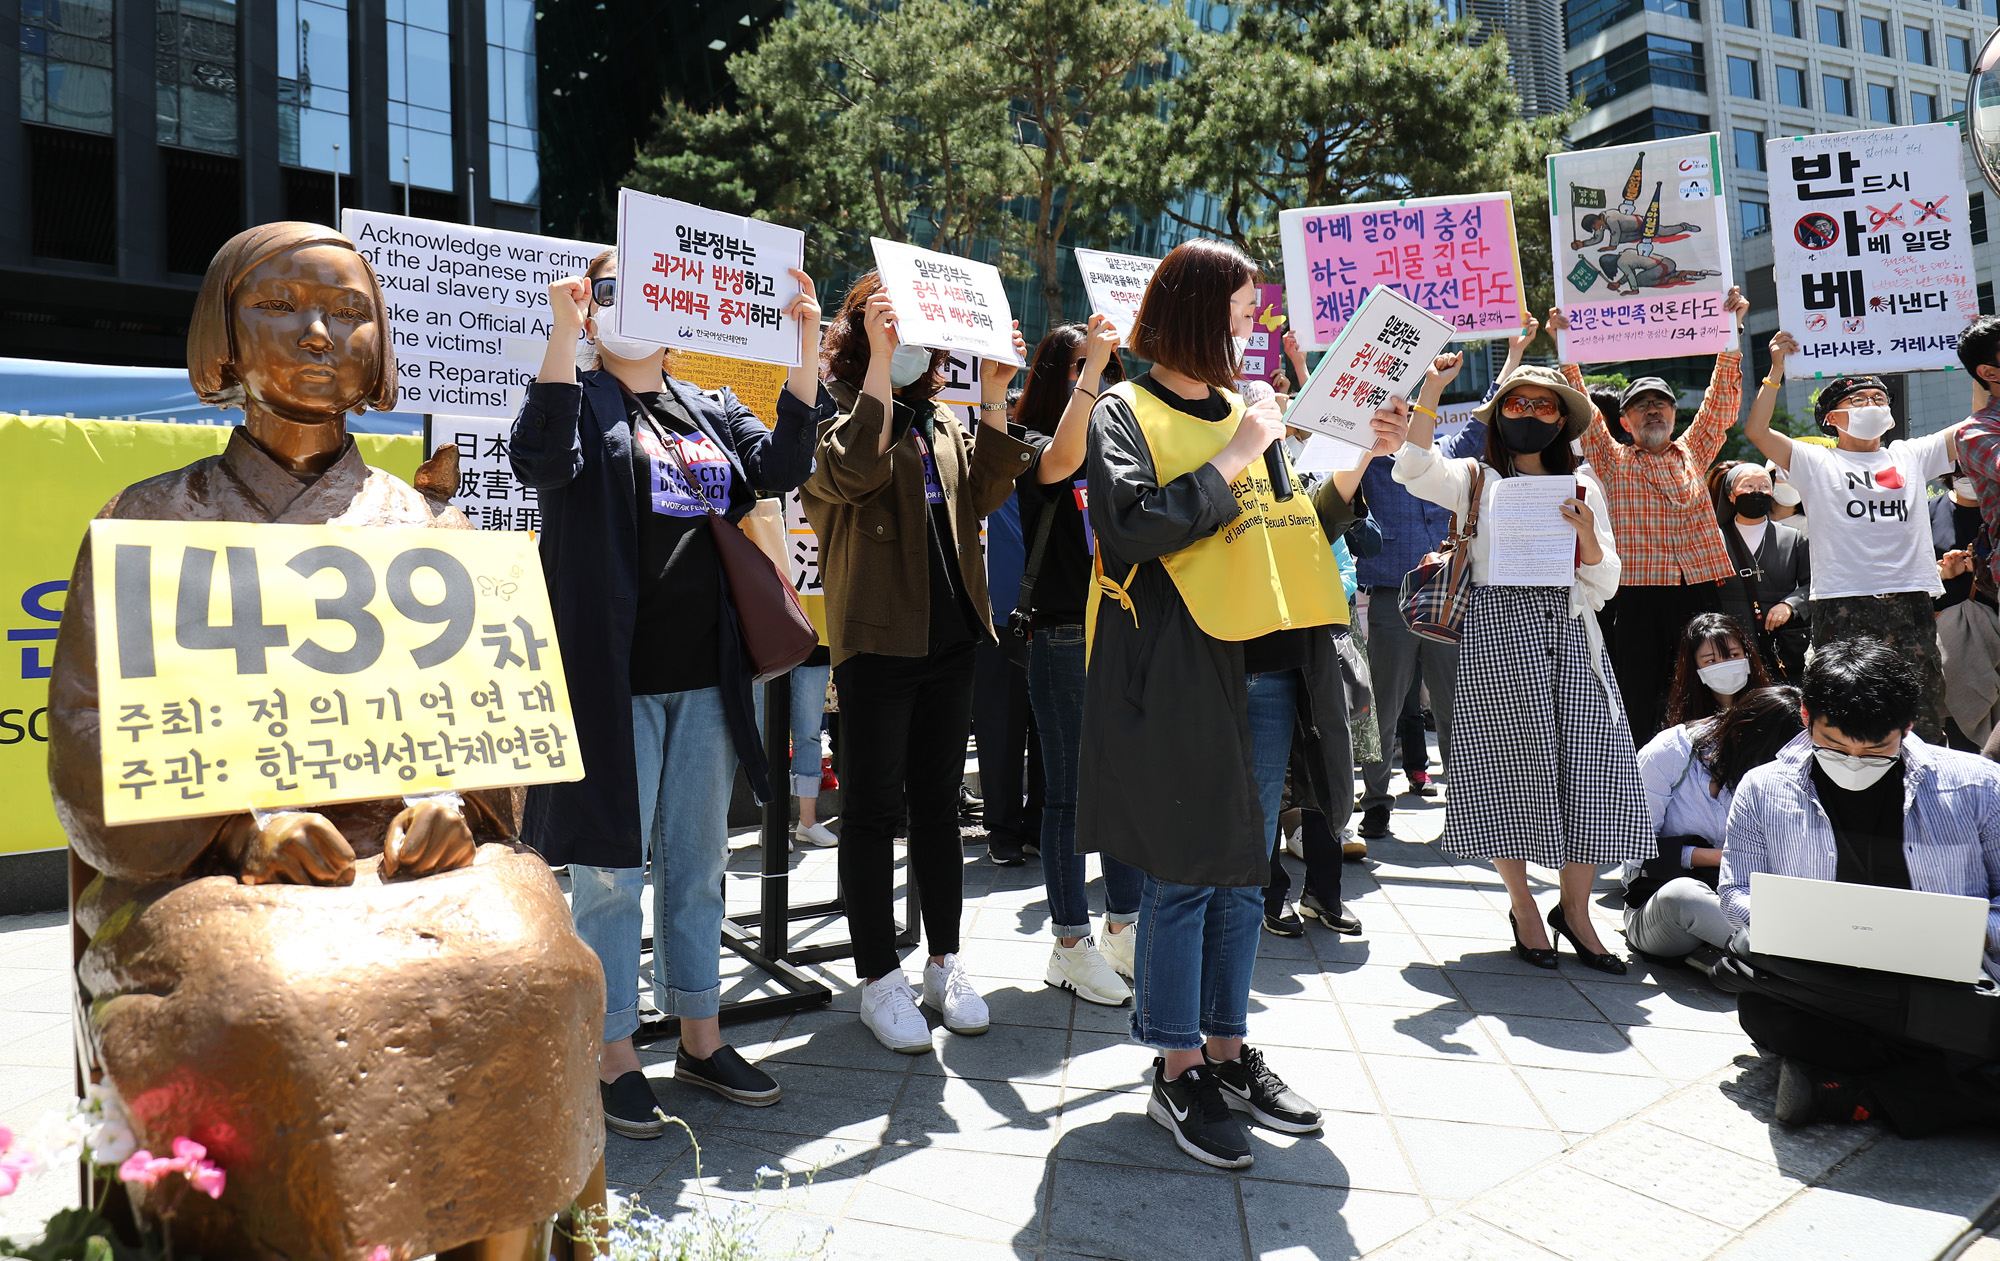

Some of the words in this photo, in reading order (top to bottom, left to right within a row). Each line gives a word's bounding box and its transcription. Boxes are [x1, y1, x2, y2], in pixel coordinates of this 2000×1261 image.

[1791, 151, 1911, 201] 반드시
[1306, 215, 1352, 243] 아베
[1361, 210, 1425, 243] 일당에
[1434, 206, 1482, 242] 충성
[360, 223, 501, 260] Acknowledge
[507, 245, 544, 263] war
[675, 225, 757, 266] 일본정부는
[1902, 229, 1952, 253] 일당
[361, 248, 382, 263] of
[387, 251, 420, 269] the
[427, 254, 527, 282] Japanese
[652, 252, 705, 285] 과거사
[712, 264, 776, 297] 반성하고
[914, 259, 972, 286] 일본정부는
[1311, 257, 1357, 287] 하는
[1373, 243, 1425, 280] 괴물
[1433, 237, 1491, 278] 집단
[378, 272, 429, 293] exual
[436, 278, 509, 305] slavery
[515, 289, 551, 309] sys
[912, 280, 939, 300] 공식
[944, 285, 988, 307] 사죄하고
[1462, 271, 1516, 308] 타도
[426, 311, 451, 326] an
[459, 311, 525, 334] Official
[642, 283, 710, 321] 역사왜곡
[718, 297, 782, 331] 중지하라
[919, 302, 946, 323] 법적
[949, 306, 994, 331] 배상하라
[1452, 314, 1478, 329] 134
[392, 327, 419, 346] he
[426, 332, 502, 355] victims!
[1377, 314, 1421, 355] 일본정부는
[1670, 327, 1698, 341] 134
[1803, 339, 1882, 359] 나라사랑,
[1890, 334, 1962, 352] 겨레사랑
[396, 358, 421, 378] ke
[429, 360, 537, 386] Reparatio
[1350, 343, 1379, 371] 공식
[1373, 352, 1409, 382] 사죄하고
[398, 385, 421, 401] he
[428, 385, 507, 407] victims!
[1329, 372, 1358, 401] 법적
[1352, 380, 1390, 410] 배상하라
[1434, 410, 1472, 429] plan
[454, 432, 509, 463] 日本
[1846, 500, 1908, 522] 아베
[1225, 532, 1235, 545] of
[1264, 515, 1288, 529] Sexual
[1290, 514, 1318, 530] Slavery!
[115, 543, 548, 679] 1439차
[116, 697, 224, 742] 주최:
[119, 748, 228, 799] 주관:
[255, 723, 567, 792] 한국여성단체연합
[1851, 924, 1873, 932] gram
